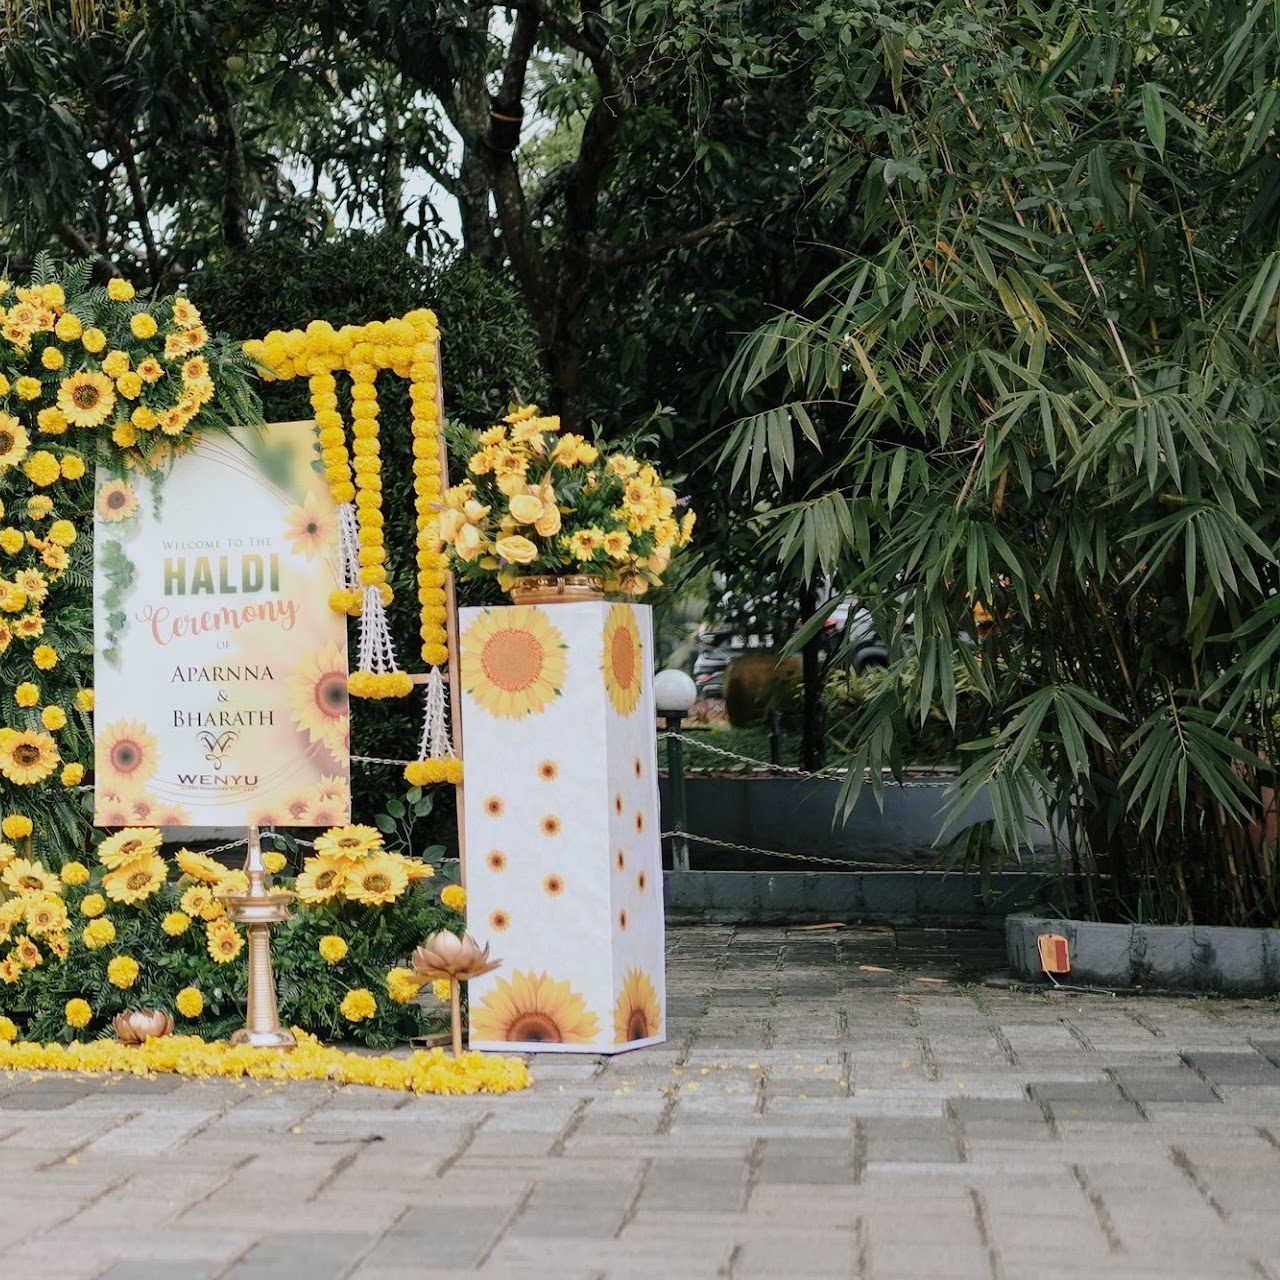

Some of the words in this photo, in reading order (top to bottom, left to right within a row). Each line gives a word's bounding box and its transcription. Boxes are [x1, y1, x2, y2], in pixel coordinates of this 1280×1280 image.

[162, 540, 221, 550] WELCOME
[227, 538, 243, 548] TO
[249, 537, 272, 547] THE
[163, 553, 280, 596] HALDI
[135, 599, 300, 646] Ceremony
[216, 640, 231, 650] OF
[171, 665, 274, 683] APARNNA
[217, 689, 229, 702] &
[173, 709, 274, 727] BHARATH
[177, 774, 258, 786] WENYU
